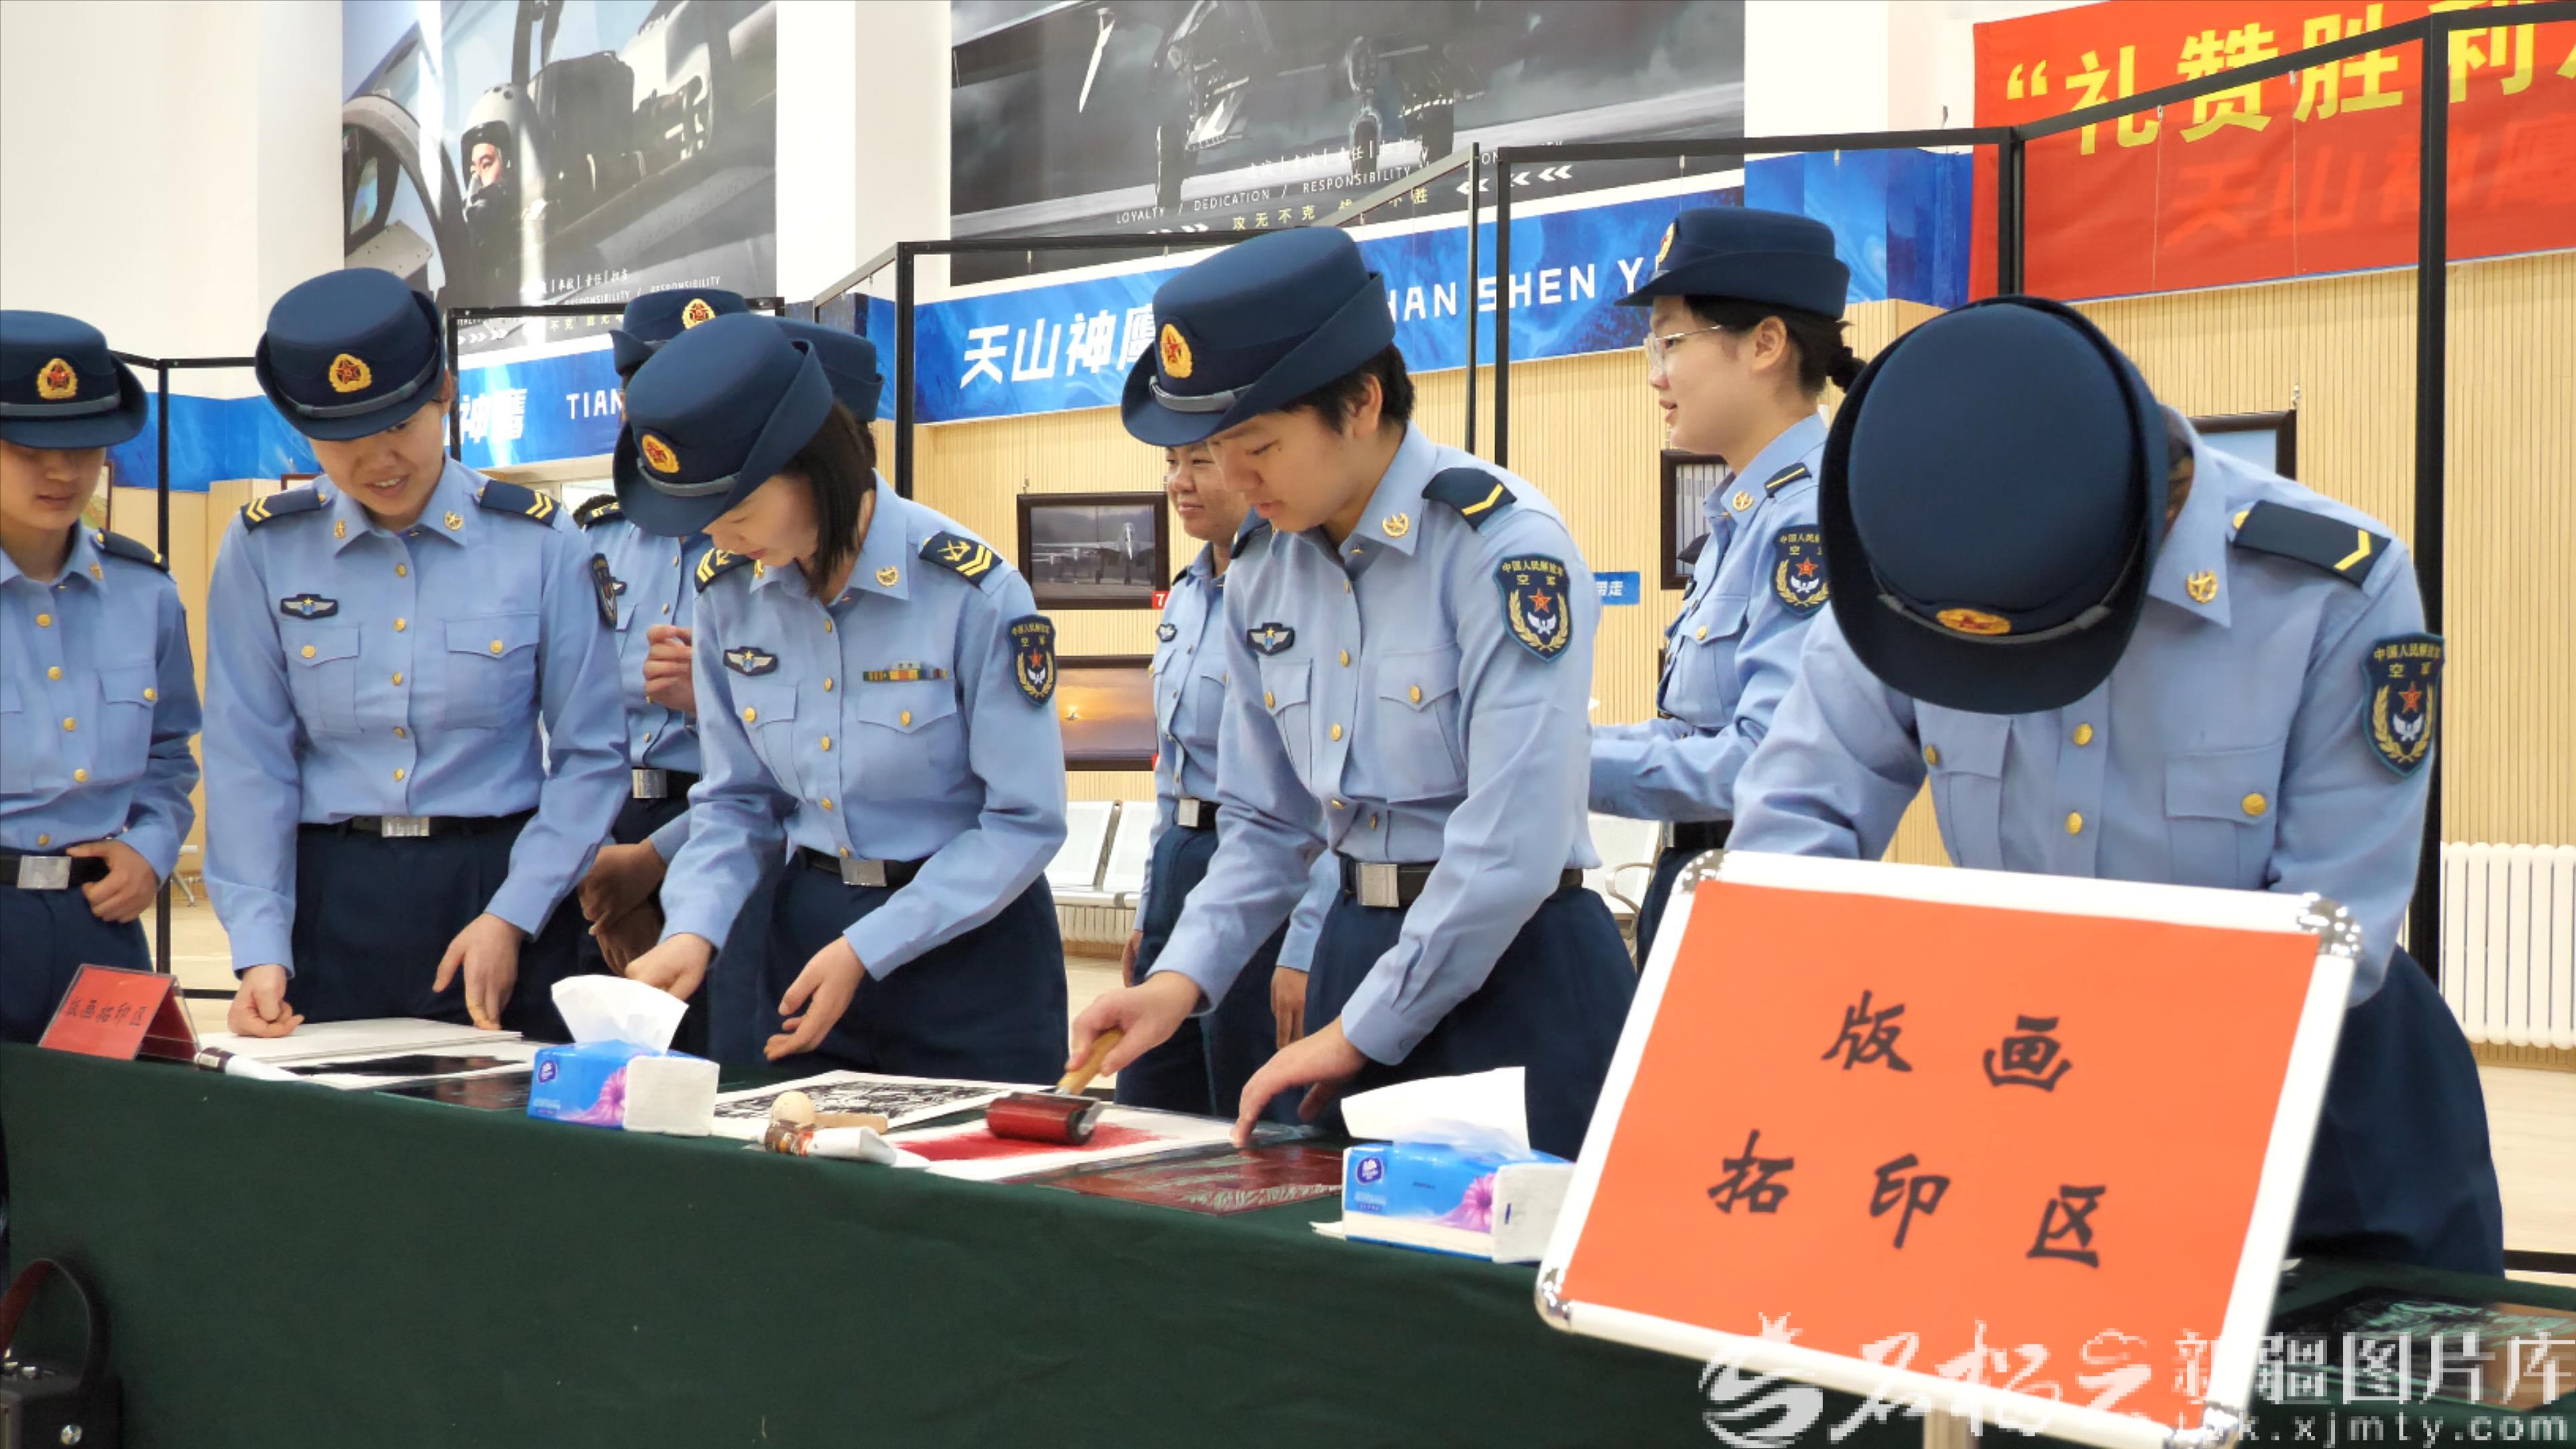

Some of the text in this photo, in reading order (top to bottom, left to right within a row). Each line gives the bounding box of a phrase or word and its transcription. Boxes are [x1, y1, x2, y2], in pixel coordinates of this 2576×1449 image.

[2006, 0, 2576, 155] “礼赞胜利
[1116, 207, 1165, 224] LOYALTY
[1194, 189, 1270, 211] DEDICATION
[1303, 166, 1411, 194] RESPONSIBILITY
[1232, 205, 1316, 231] 攻无不克
[1478, 264, 1595, 312] SHEN
[960, 304, 1155, 389] 天山神鹰
[566, 388, 623, 419] TIAN
[1821, 989, 2073, 1093] 版画
[1707, 1128, 2107, 1269] 拓印区
